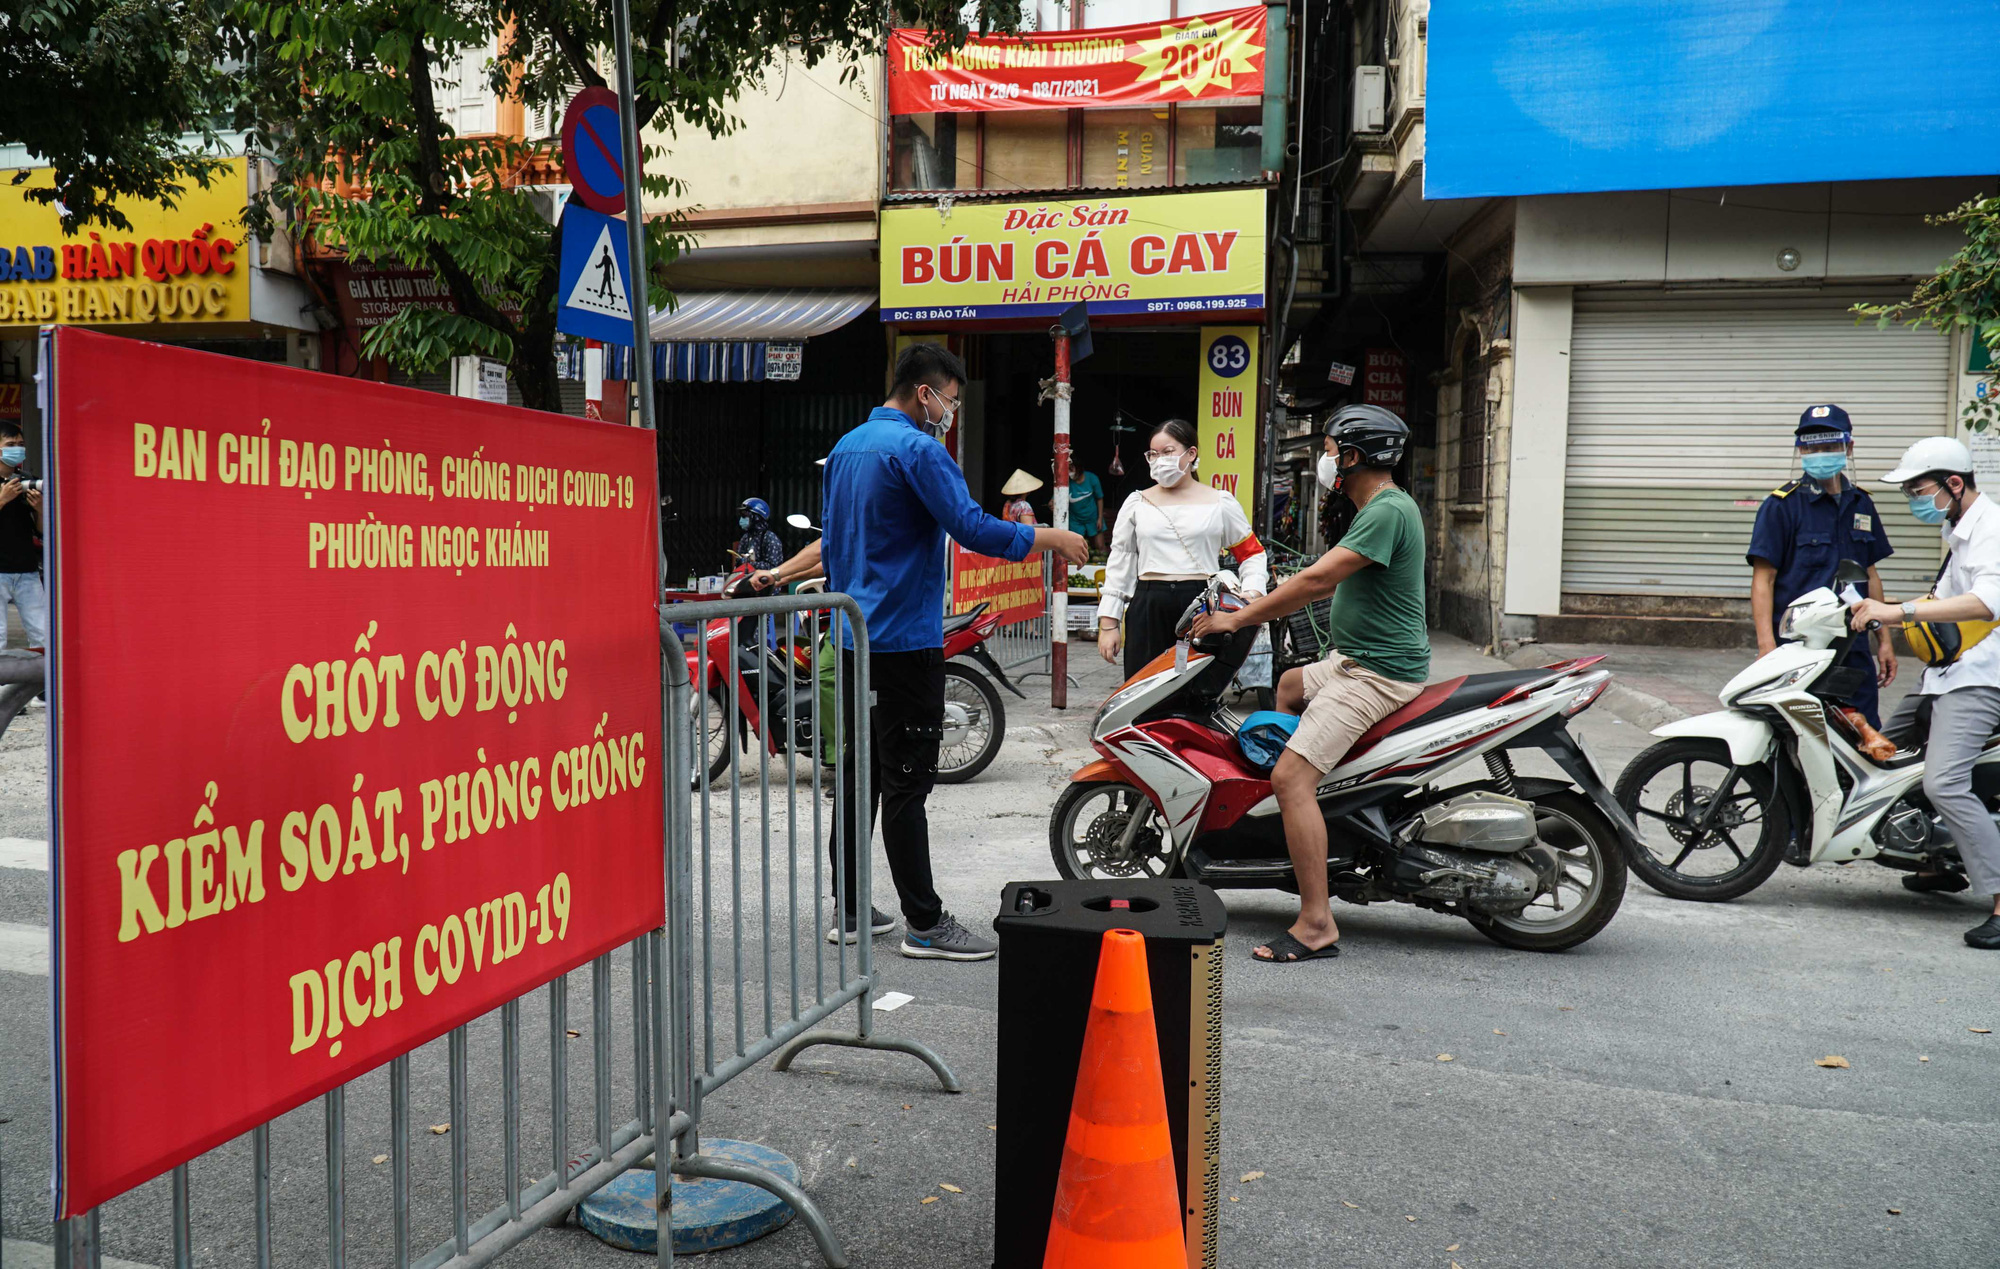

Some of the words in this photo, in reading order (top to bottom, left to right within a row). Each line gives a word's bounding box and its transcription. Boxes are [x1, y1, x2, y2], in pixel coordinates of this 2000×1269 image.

[1004, 42, 1048, 68] KHAI
[1160, 43, 1232, 82] 20%
[930, 80, 948, 100] TỪ
[950, 80, 986, 100] NGÀY
[989, 83, 1020, 99] 28/6
[1032, 79, 1100, 98] 08/7/2021
[1116, 131, 1129, 187] MINH
[1003, 205, 1064, 234] Đặc
[1067, 204, 1129, 228] Sản
[61, 232, 136, 280] HÀN
[141, 222, 237, 282] QUỐC
[901, 235, 1014, 286] BÚN
[1034, 231, 1110, 280] CÁ
[1129, 230, 1239, 277] CAY
[61, 285, 132, 319] HAN
[135, 282, 227, 323] QUOC
[1001, 281, 1046, 303] HẢI
[1051, 280, 1131, 302] PHÒNG
[1147, 301, 1174, 312] SĐT:
[1176, 298, 1248, 310] 0968.199.925
[894, 310, 914, 320] ĐC:
[915, 310, 928, 320] 83
[930, 307, 953, 320] ĐÀO
[954, 306, 977, 319] TẤN
[1212, 344, 1246, 369] 83
[1368, 352, 1403, 367] BÚN
[1211, 385, 1243, 418] BÚN
[1367, 389, 1404, 403] NEM
[1216, 427, 1236, 459] CÁ
[133, 422, 207, 482] BAN
[217, 418, 272, 487] CHỈ
[278, 441, 337, 499] ĐẠO
[344, 438, 435, 502] PHÒNG,
[441, 445, 511, 502] CHỐNG
[516, 471, 558, 512] DỊCH
[562, 474, 634, 509] COVID-19
[308, 511, 414, 569] PHƯỜNG
[420, 527, 480, 576] NGỌC
[485, 520, 550, 568] KHÁNH
[281, 620, 405, 744] CHỐT
[415, 640, 467, 722] CƠ
[474, 622, 568, 724] ĐỘNG
[1316, 777, 1359, 794] 125
[116, 780, 266, 943] KIỂM
[279, 772, 410, 892] SOÁT,
[420, 747, 542, 852] PHÒNG
[550, 711, 646, 813] CHỐNG
[288, 936, 403, 1058] DỊCH
[413, 872, 571, 996] COVID-19
